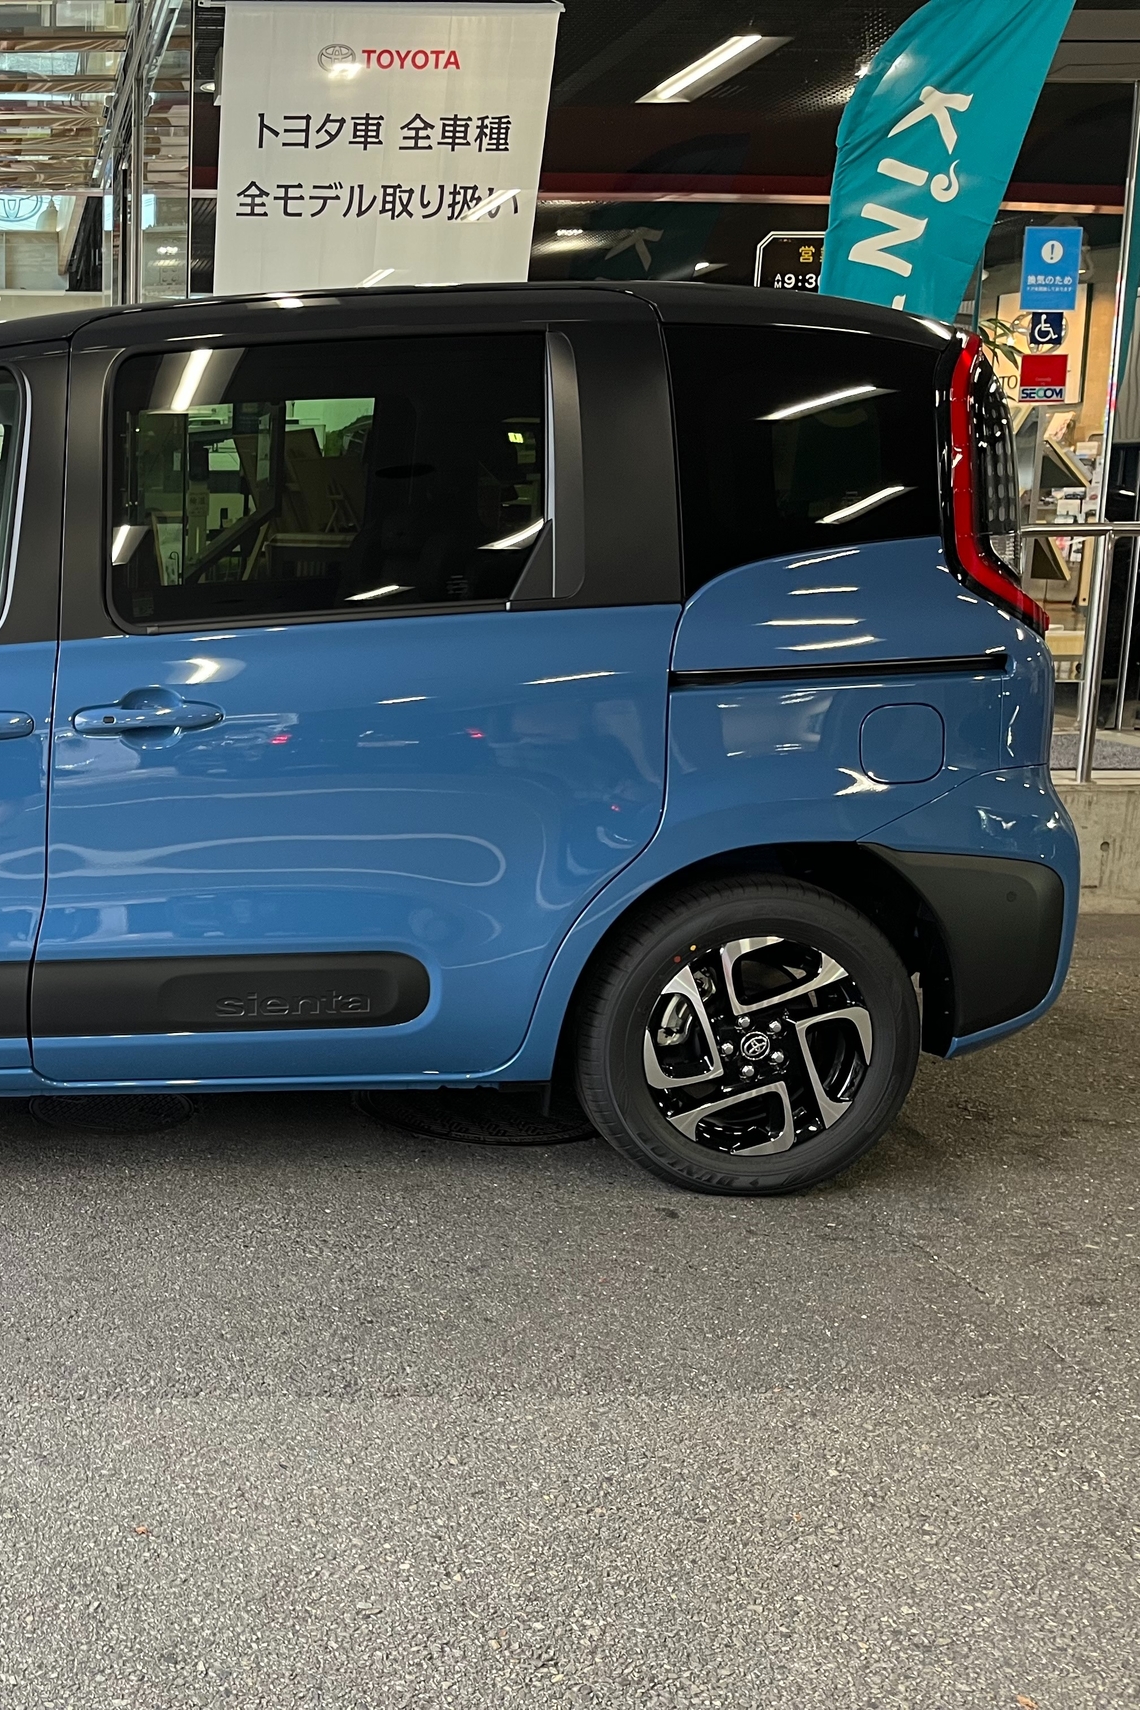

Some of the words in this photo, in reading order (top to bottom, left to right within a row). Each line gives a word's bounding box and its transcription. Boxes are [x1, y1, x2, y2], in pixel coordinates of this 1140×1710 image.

[362, 49, 461, 70] TOYOTA
[256, 112, 385, 151] トヨタ車
[398, 113, 512, 152] 全車種
[235, 180, 521, 221] 全モデル取り扱い
[799, 245, 825, 263] 営
[783, 273, 821, 289] 9:3
[1027, 275, 1073, 285] 換気のため
[1021, 387, 1063, 399] SECOM
[214, 989, 371, 1017] sienta
